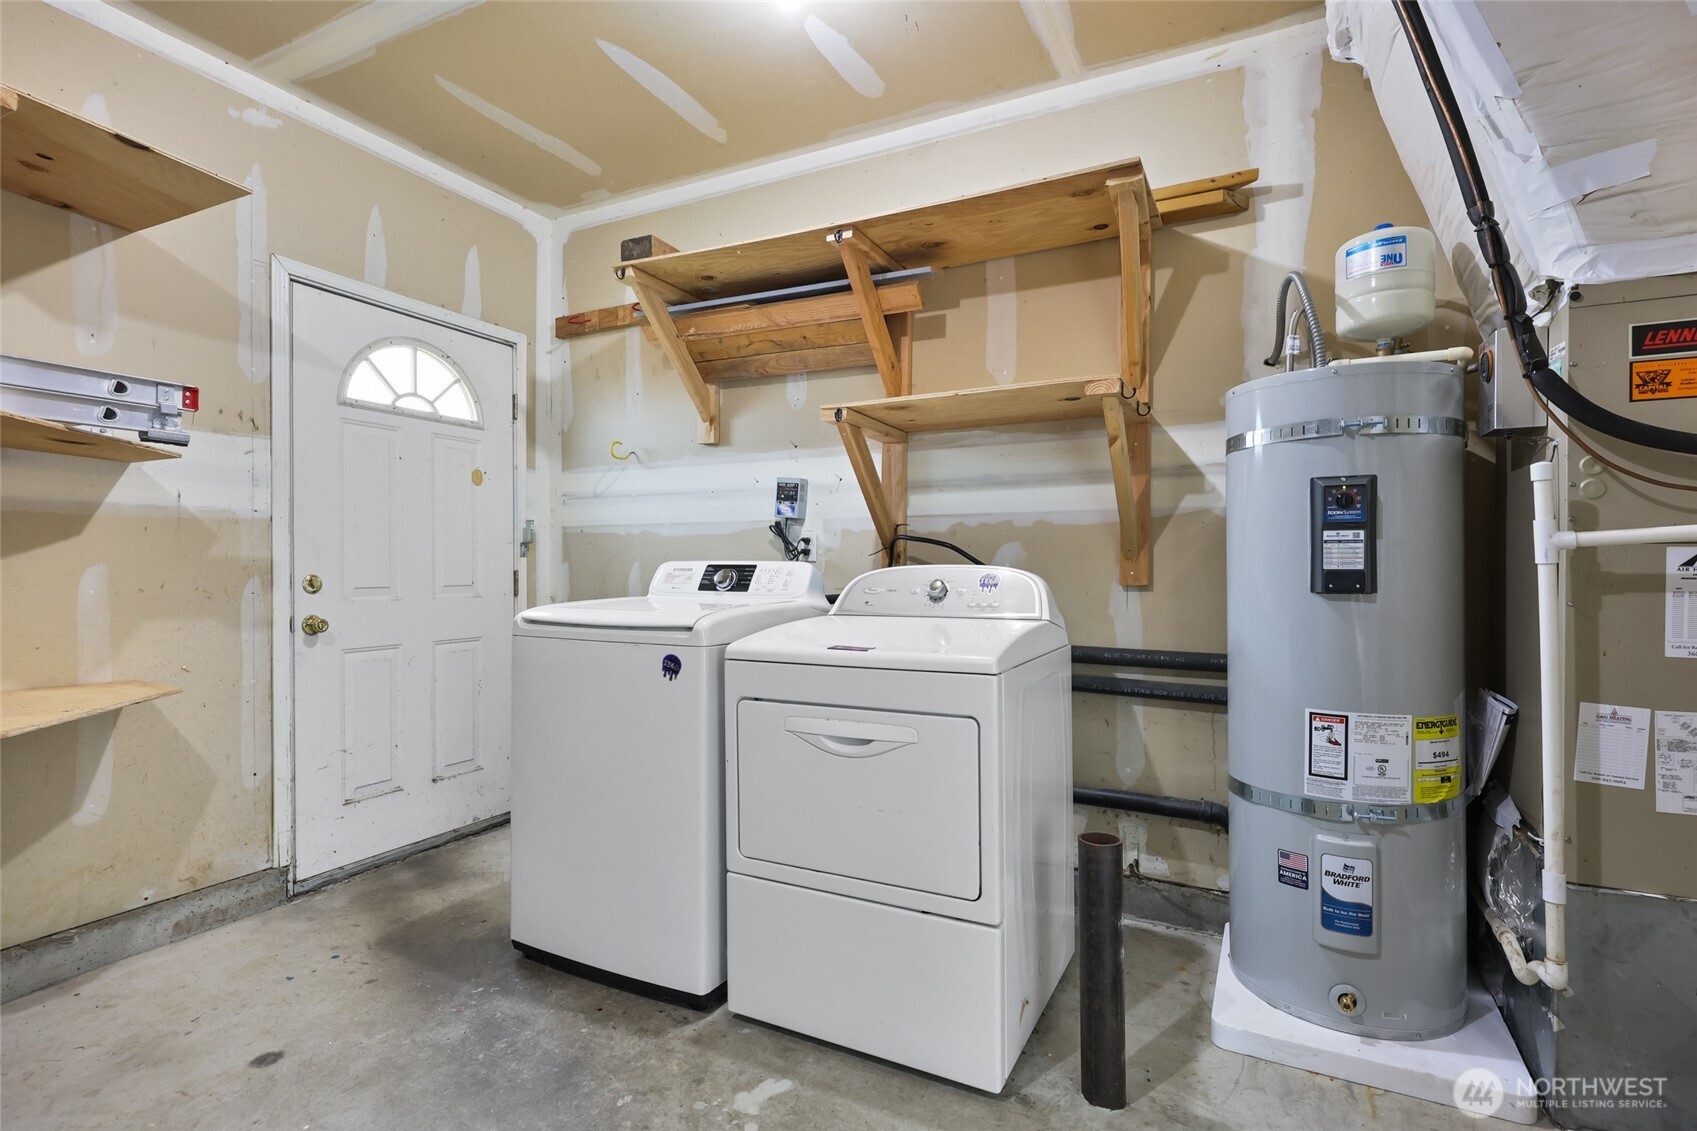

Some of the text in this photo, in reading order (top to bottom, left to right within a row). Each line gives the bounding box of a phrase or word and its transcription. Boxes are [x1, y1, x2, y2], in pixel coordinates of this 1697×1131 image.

[1432, 751, 1450, 760] $494
[1280, 869, 1308, 882] AMERICA
[1324, 870, 1370, 882] BRADFORD
[1332, 878, 1360, 888] WHITE
